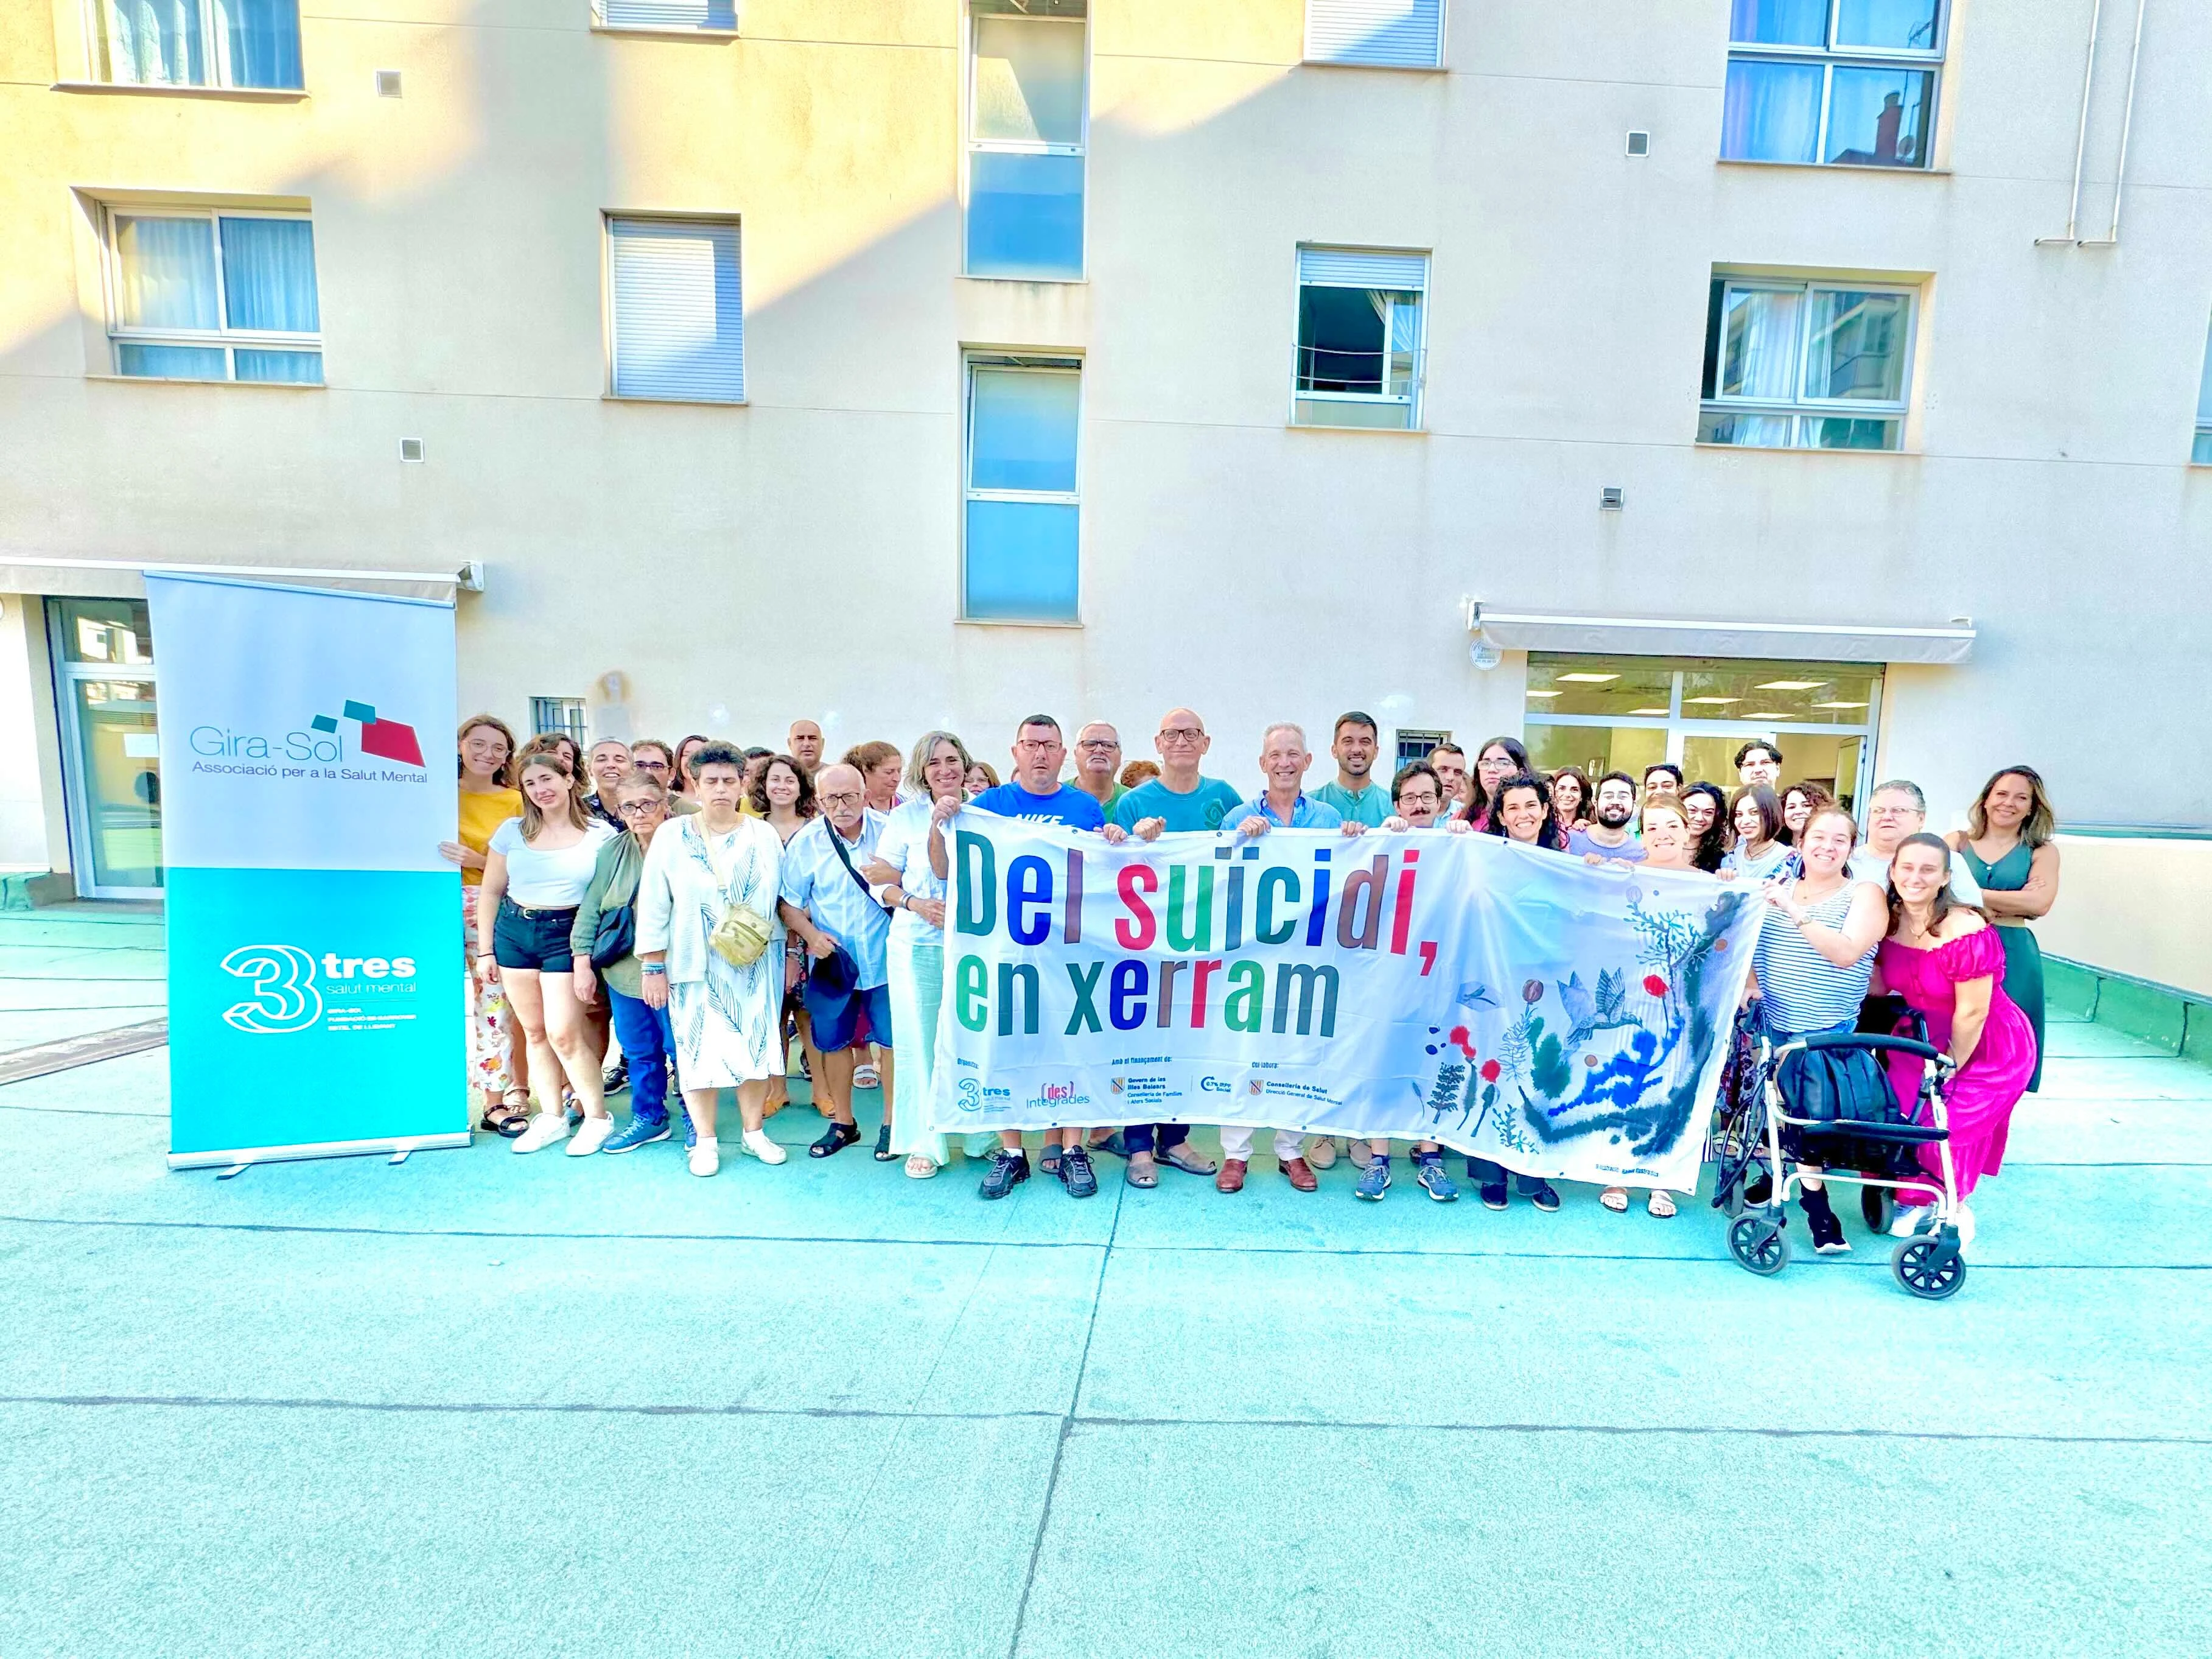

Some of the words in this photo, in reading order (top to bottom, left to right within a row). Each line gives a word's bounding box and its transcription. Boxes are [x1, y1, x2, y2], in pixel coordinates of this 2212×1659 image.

[191, 726, 343, 762] Gira-Sol
[192, 761, 278, 776] Associació
[282, 768, 306, 779] per
[310, 770, 320, 778] a
[324, 768, 336, 779] la
[341, 769, 377, 780] Salut
[382, 771, 428, 783] Mental
[1016, 813, 1064, 825] NIKE
[956, 830, 1083, 946] Del
[1115, 847, 1438, 976] suïcidi,
[321, 953, 416, 979] tres
[326, 984, 361, 994] salut
[366, 982, 416, 994] mental
[956, 955, 1040, 1037] en
[1064, 959, 1340, 1037] xerram
[1130, 1056, 1163, 1065] finançament
[983, 1087, 1010, 1096] tres
[1312, 1086, 1328, 1095] Salut
